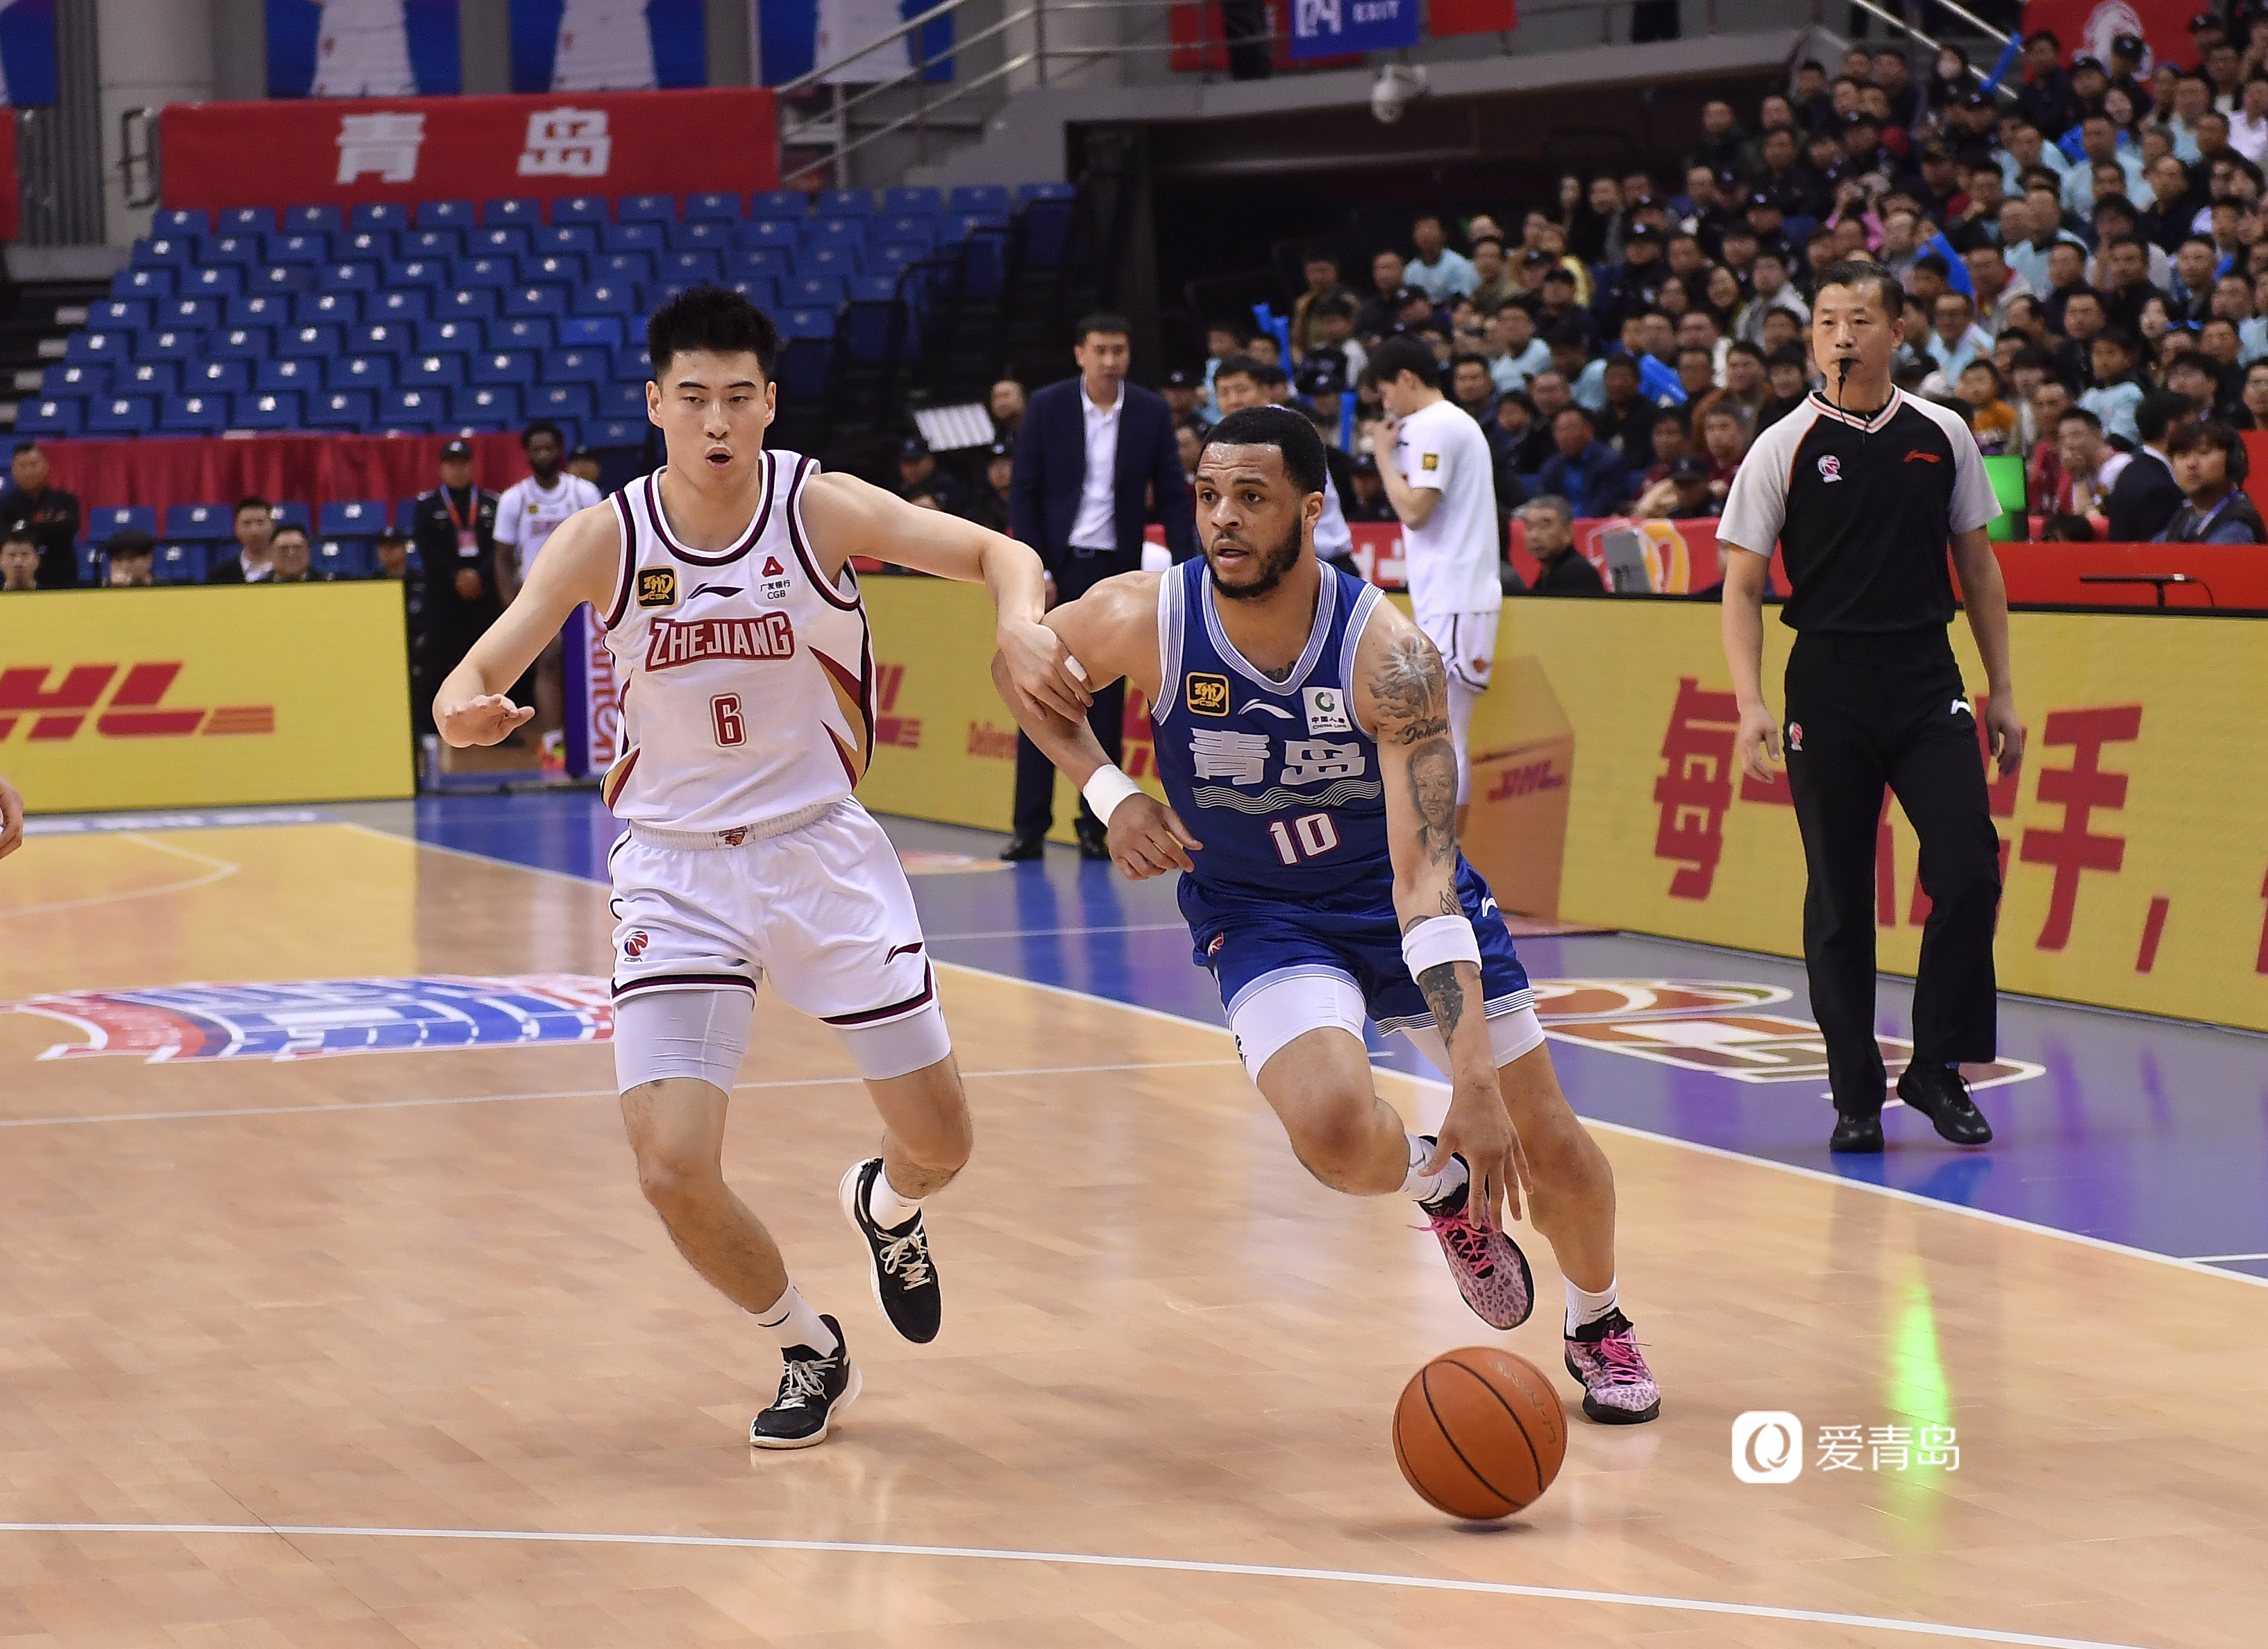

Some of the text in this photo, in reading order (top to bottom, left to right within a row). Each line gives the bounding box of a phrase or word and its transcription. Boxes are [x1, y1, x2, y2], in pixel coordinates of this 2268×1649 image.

[336, 107, 611, 185] 青岛
[759, 579, 791, 592] 广发银行
[767, 589, 786, 600] CGB
[649, 615, 793, 668] ZHEJIANG
[711, 693, 746, 747] 6
[1188, 728, 1366, 786] 青岛
[1269, 813, 1340, 865] 10
